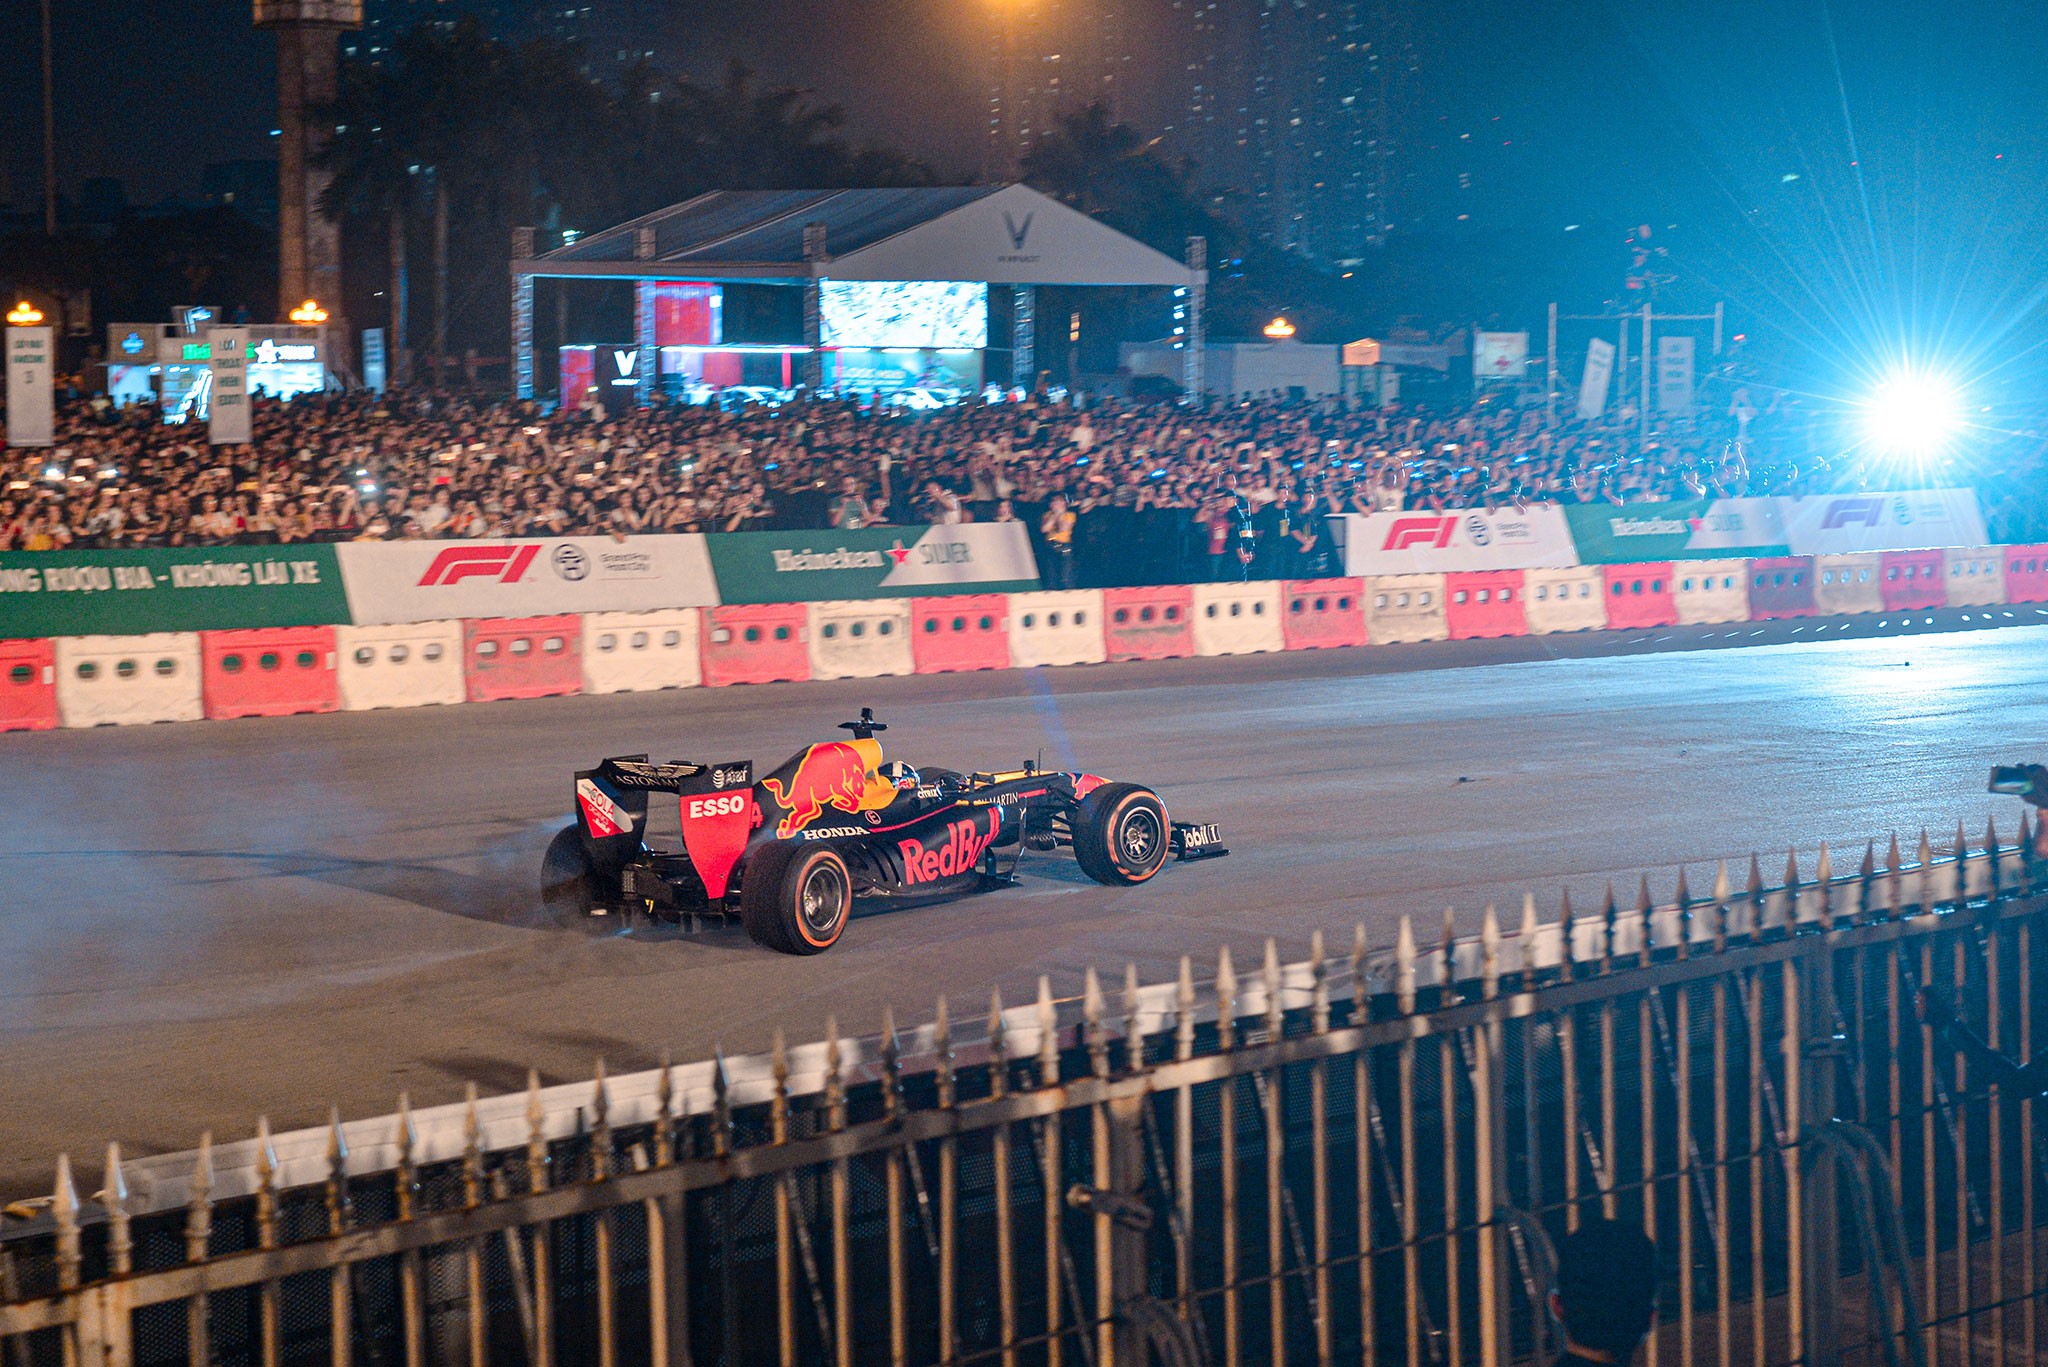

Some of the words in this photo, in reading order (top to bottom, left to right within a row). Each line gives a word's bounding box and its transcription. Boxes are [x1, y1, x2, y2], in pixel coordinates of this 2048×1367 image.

[1609, 514, 1688, 537] Heineken
[771, 547, 885, 572] Heineken
[919, 542, 973, 565] SILVER
[170, 560, 252, 588] KHÔNG
[253, 558, 289, 585] LÁI
[289, 560, 321, 585] XE
[615, 775, 661, 786] ASTON
[690, 795, 744, 819] ESSO
[802, 827, 870, 840] HONDA
